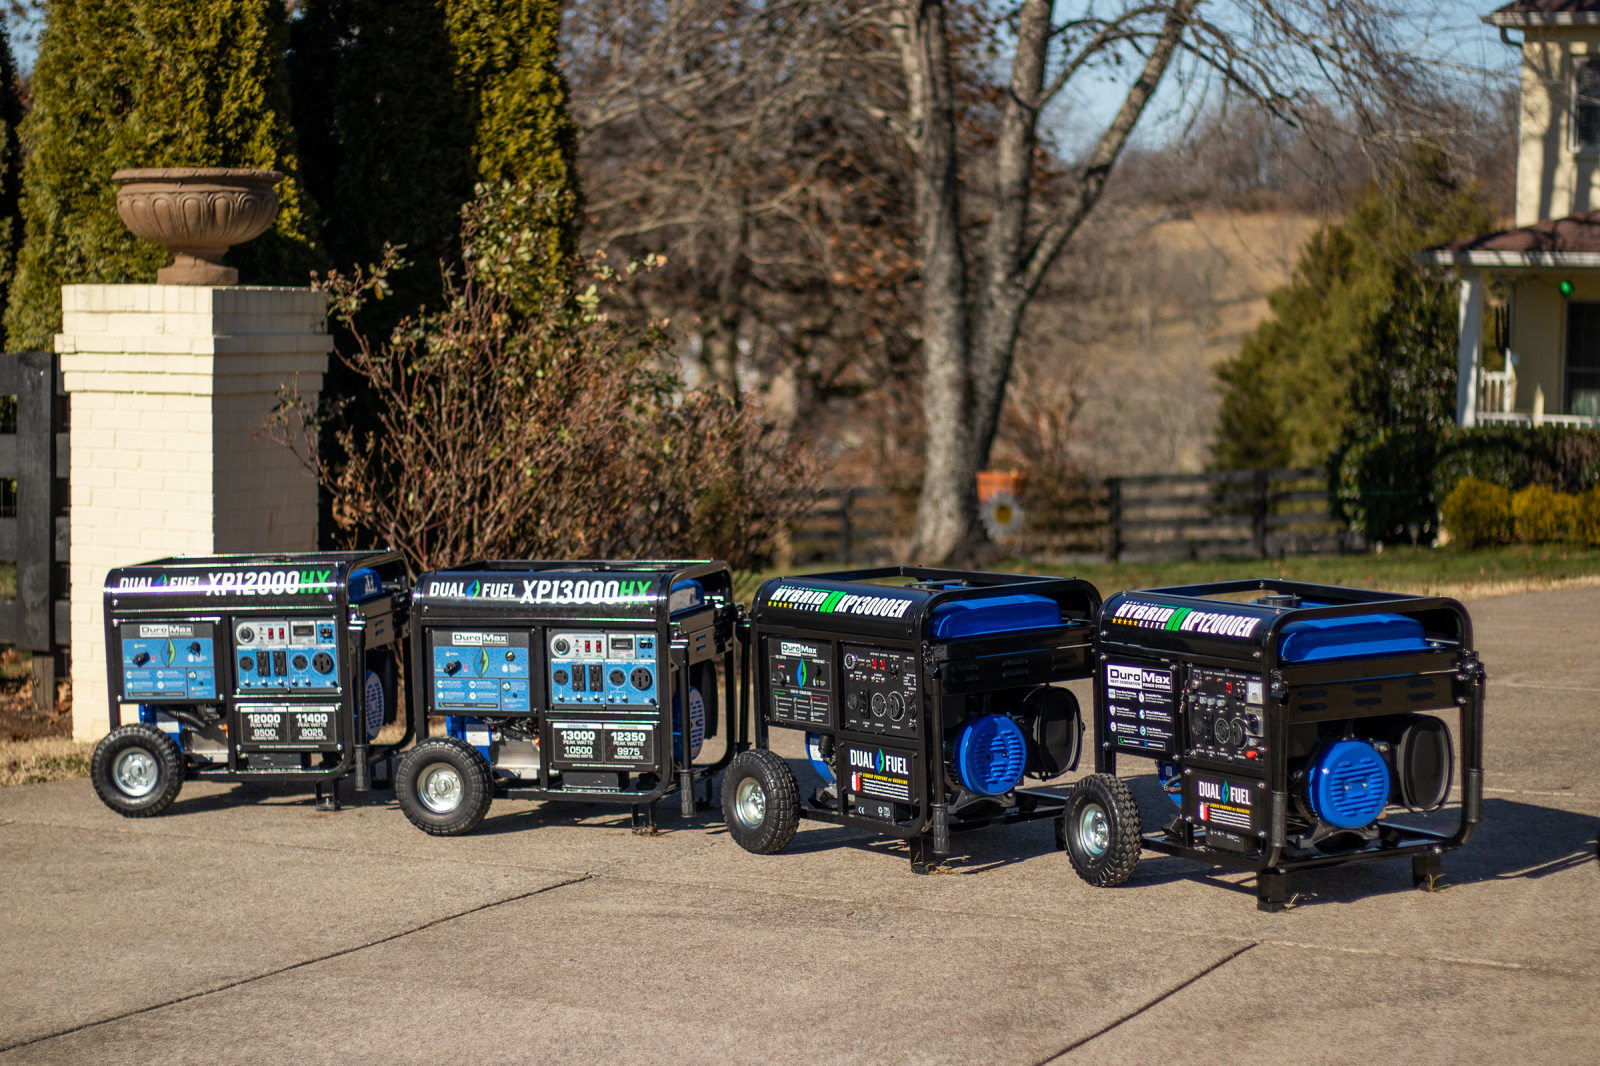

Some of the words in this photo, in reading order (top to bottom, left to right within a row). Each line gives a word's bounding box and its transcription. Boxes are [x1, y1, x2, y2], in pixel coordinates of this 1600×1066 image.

[119, 577, 152, 592] DUAL
[169, 576, 200, 592] FUEL
[206, 570, 331, 596] XP12000HX
[429, 582, 466, 598] DUAL
[482, 582, 515, 598] FUEL
[519, 580, 652, 605] XP13000HX
[770, 588, 829, 605] HYBRID
[793, 602, 820, 612] ELITE
[1114, 603, 1175, 622] HYBRID
[1138, 620, 1166, 630] ELITE
[247, 713, 281, 724] 12000
[295, 713, 329, 723] 11400
[254, 728, 276, 737] 9500
[301, 728, 324, 737] 9025
[560, 730, 596, 741] 13000
[610, 731, 647, 742] 12350
[564, 746, 593, 755] 10500
[617, 747, 640, 756] 9975
[849, 749, 875, 769] DUAL
[885, 755, 909, 775] FUEL
[1198, 781, 1221, 800] DUAL
[1230, 786, 1251, 805] FUEL
